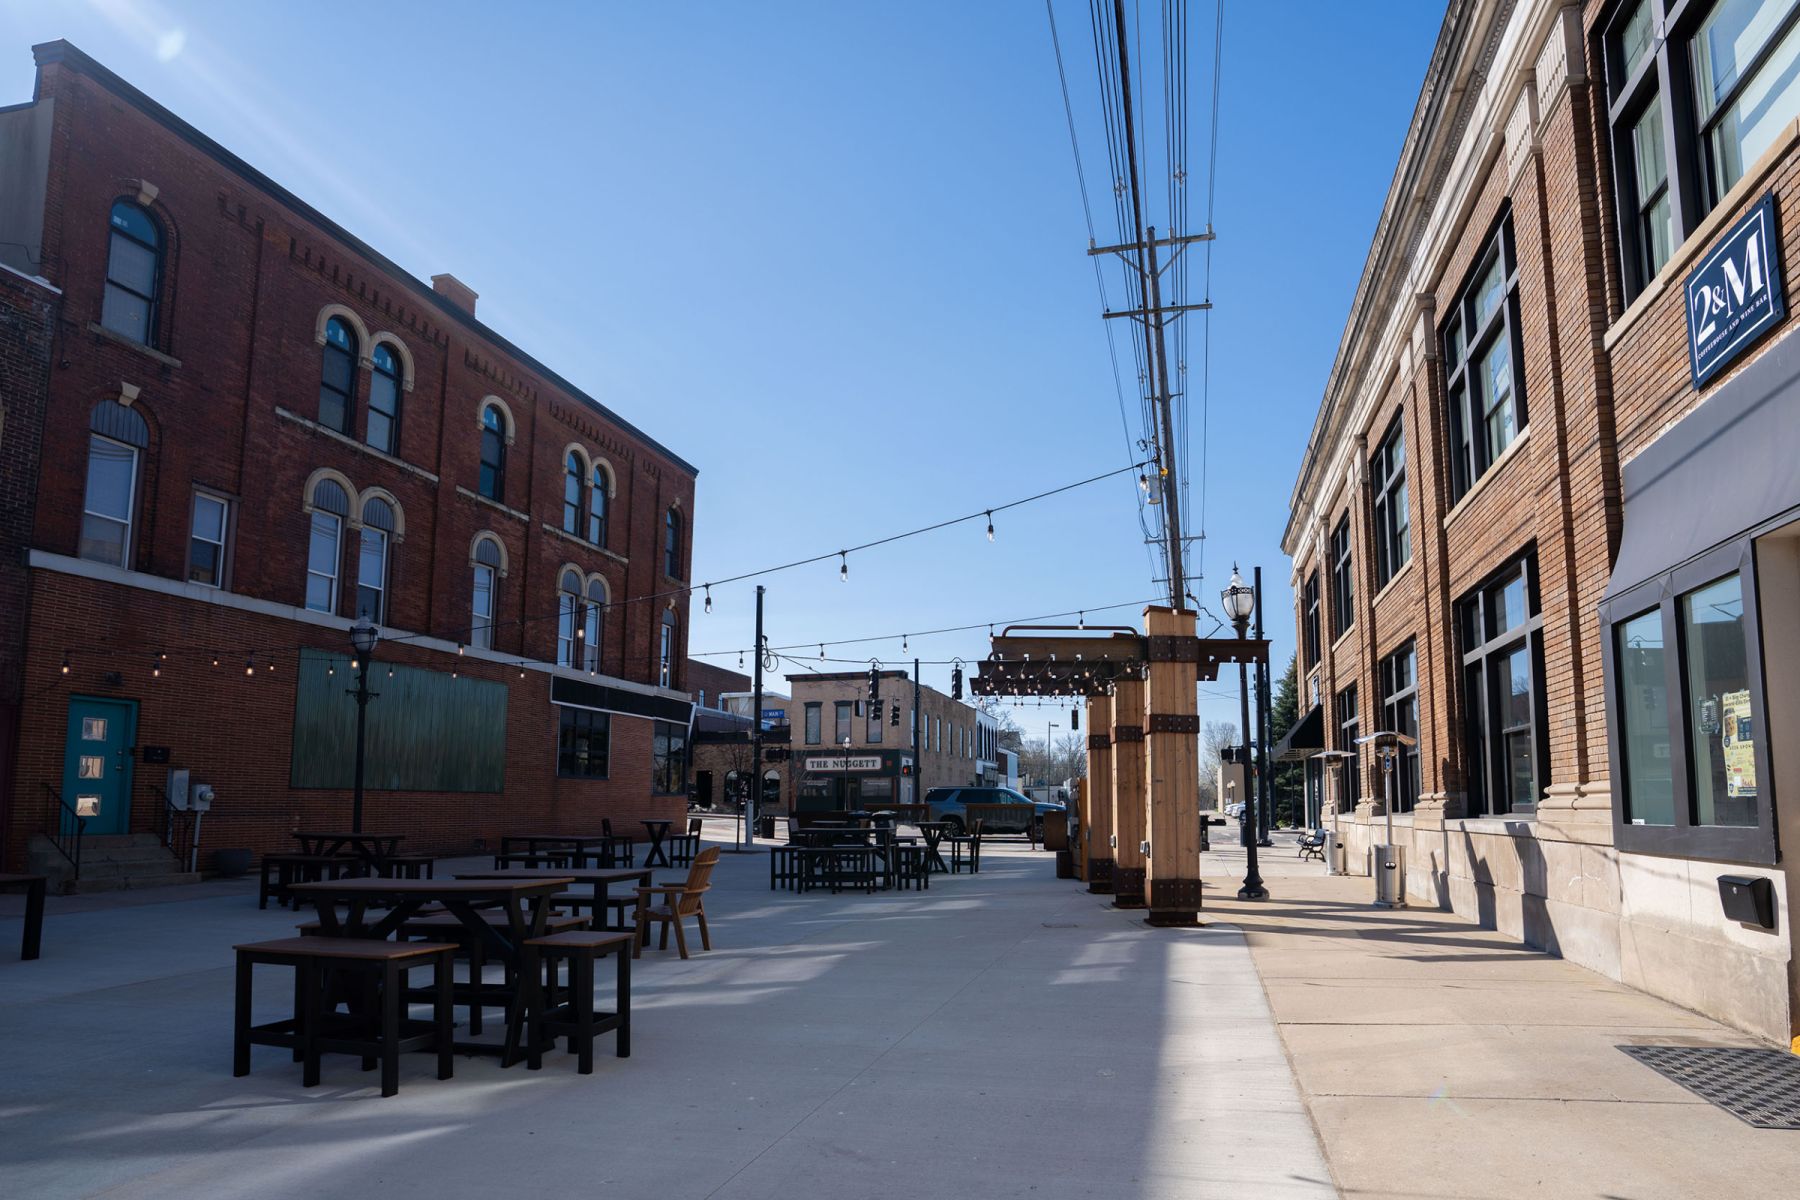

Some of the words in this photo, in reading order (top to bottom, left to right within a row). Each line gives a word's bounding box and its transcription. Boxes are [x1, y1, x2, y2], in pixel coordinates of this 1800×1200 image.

[1694, 229, 1765, 347] 2&M
[1698, 328, 1728, 360] COFFEEHOUSE
[1729, 318, 1740, 331] AND
[1740, 304, 1755, 320] WINE
[1755, 294, 1767, 308] BAR
[810, 760, 829, 769] THE
[832, 759, 877, 769] NUGGETT
